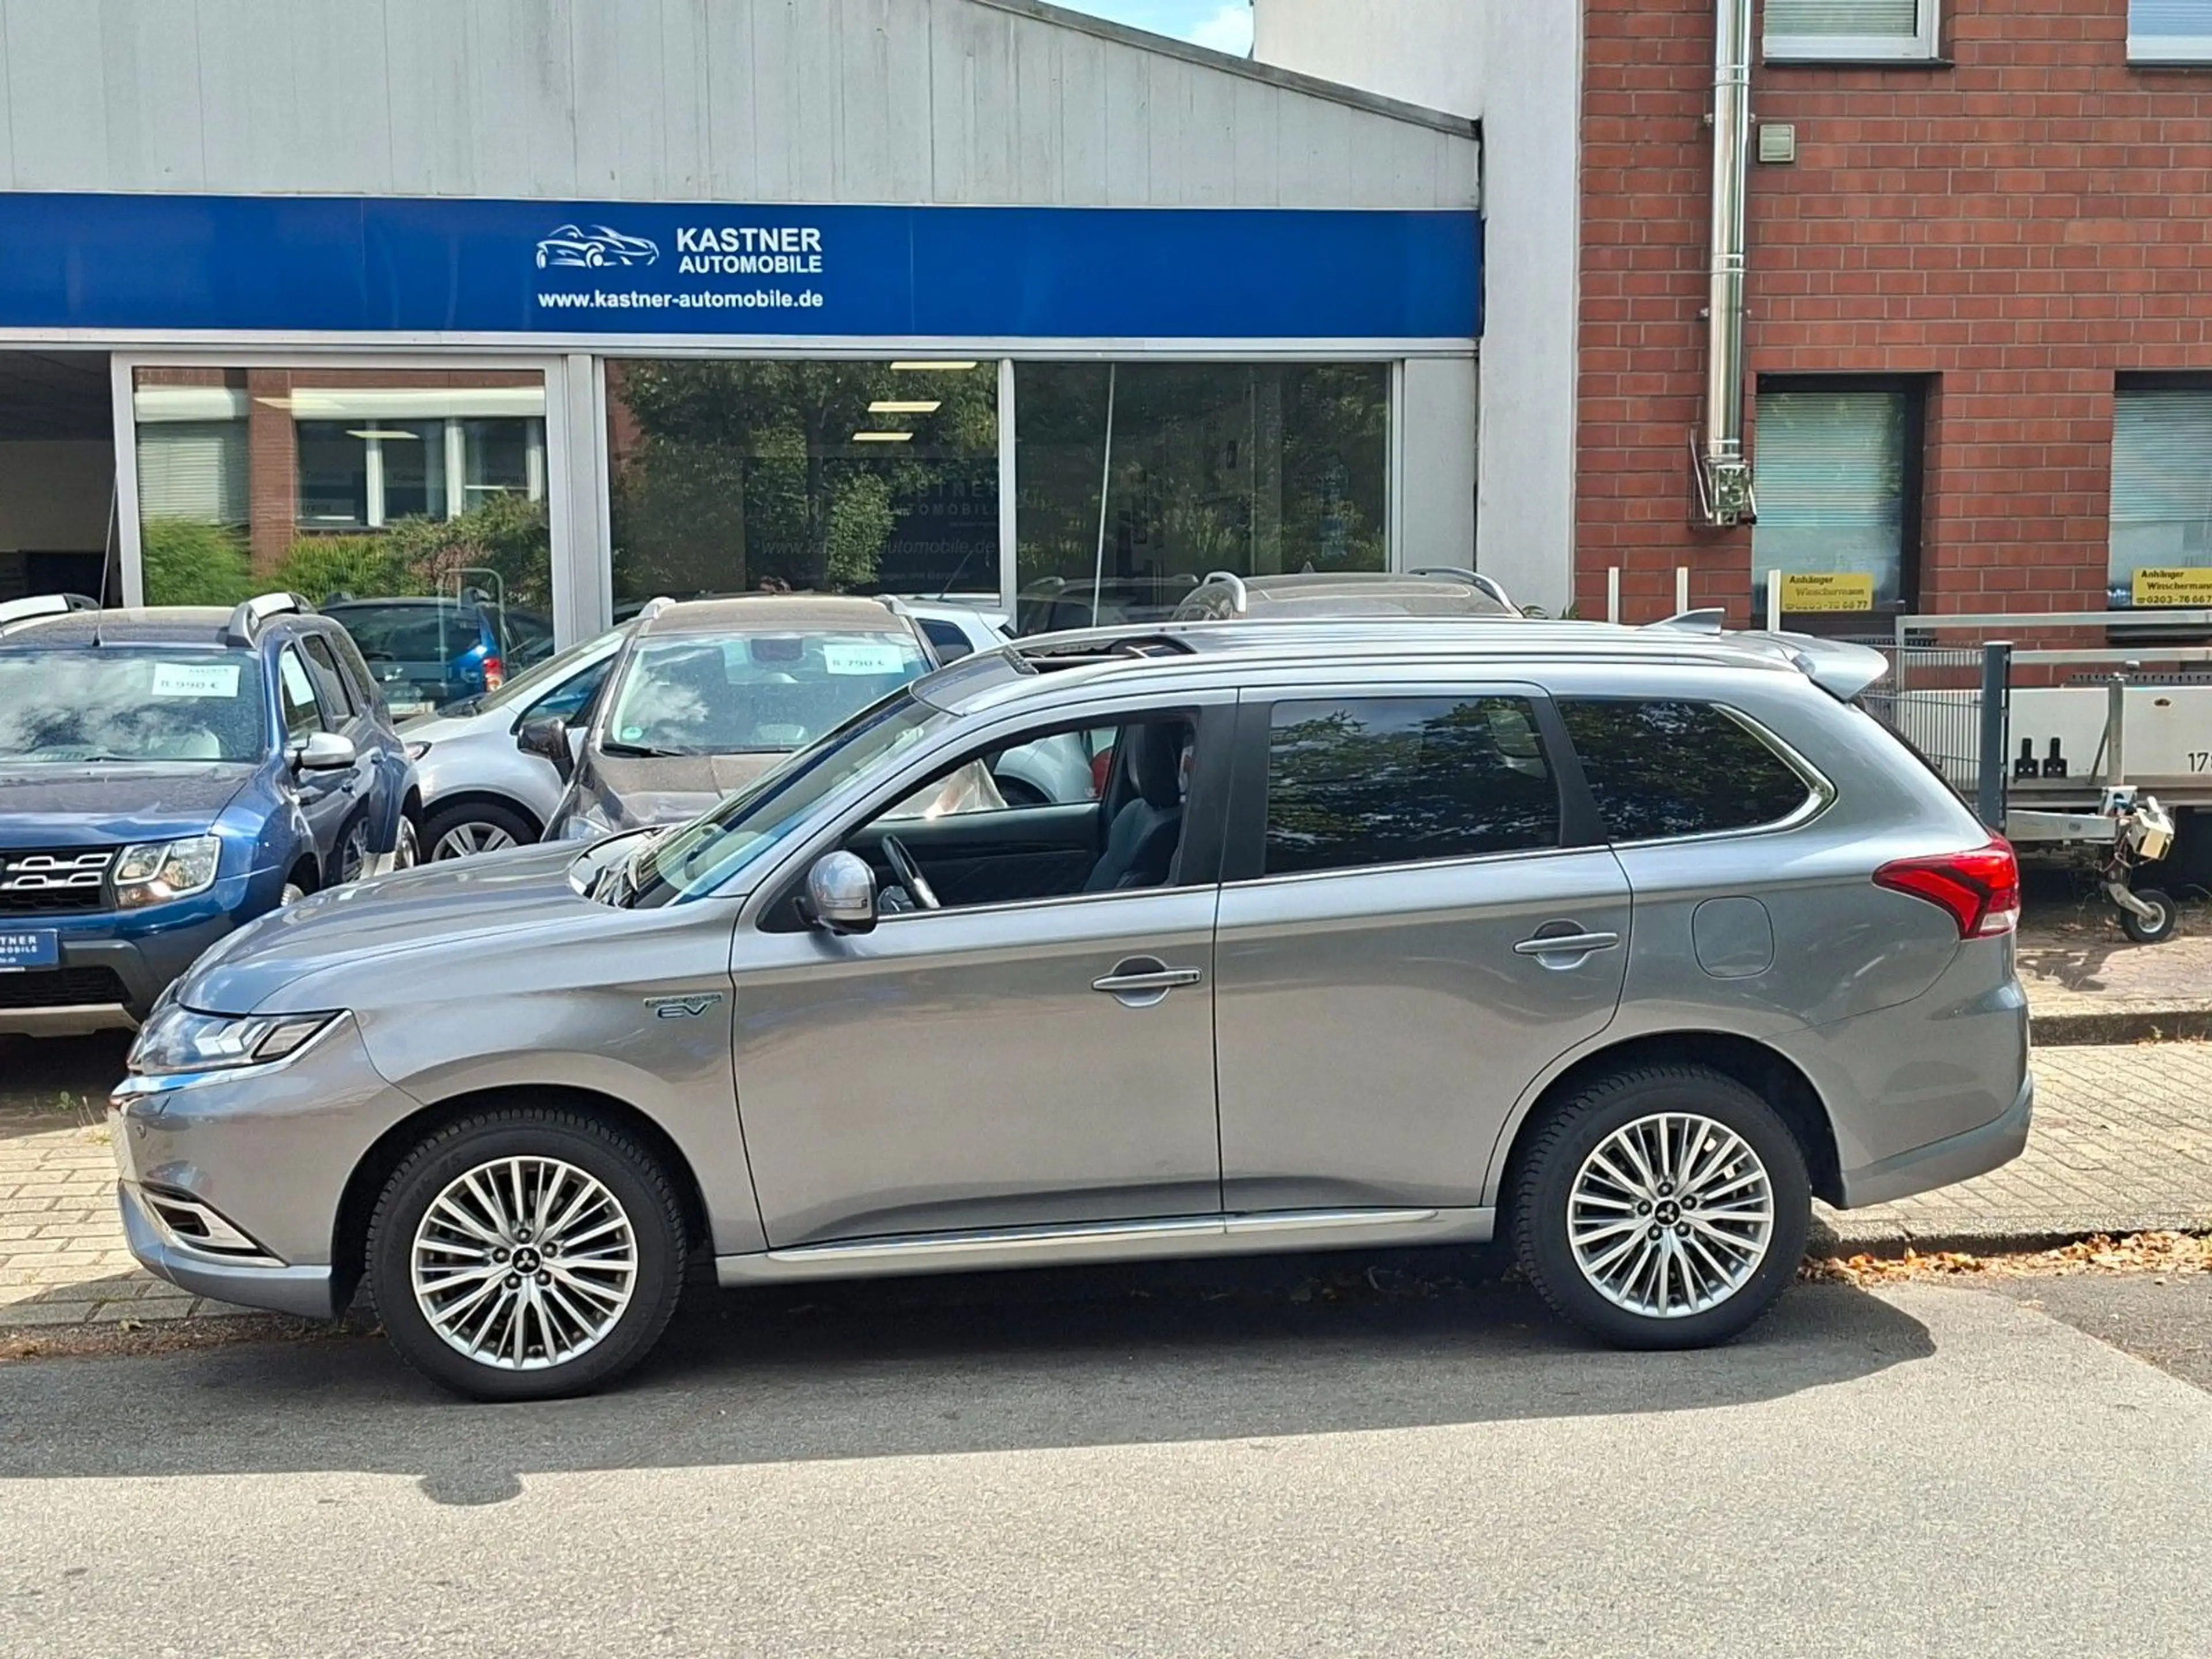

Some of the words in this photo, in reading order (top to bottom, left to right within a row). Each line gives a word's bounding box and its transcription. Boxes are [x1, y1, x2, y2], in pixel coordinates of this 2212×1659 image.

[676, 228, 822, 252] KASTNER
[679, 256, 823, 273] AUTOMOBILE
[538, 290, 824, 308] www.kastner-automobile.de
[1789, 575, 1834, 585] Anhänger
[2141, 569, 2184, 579] Anhänger
[2187, 752, 2212, 772] 17
